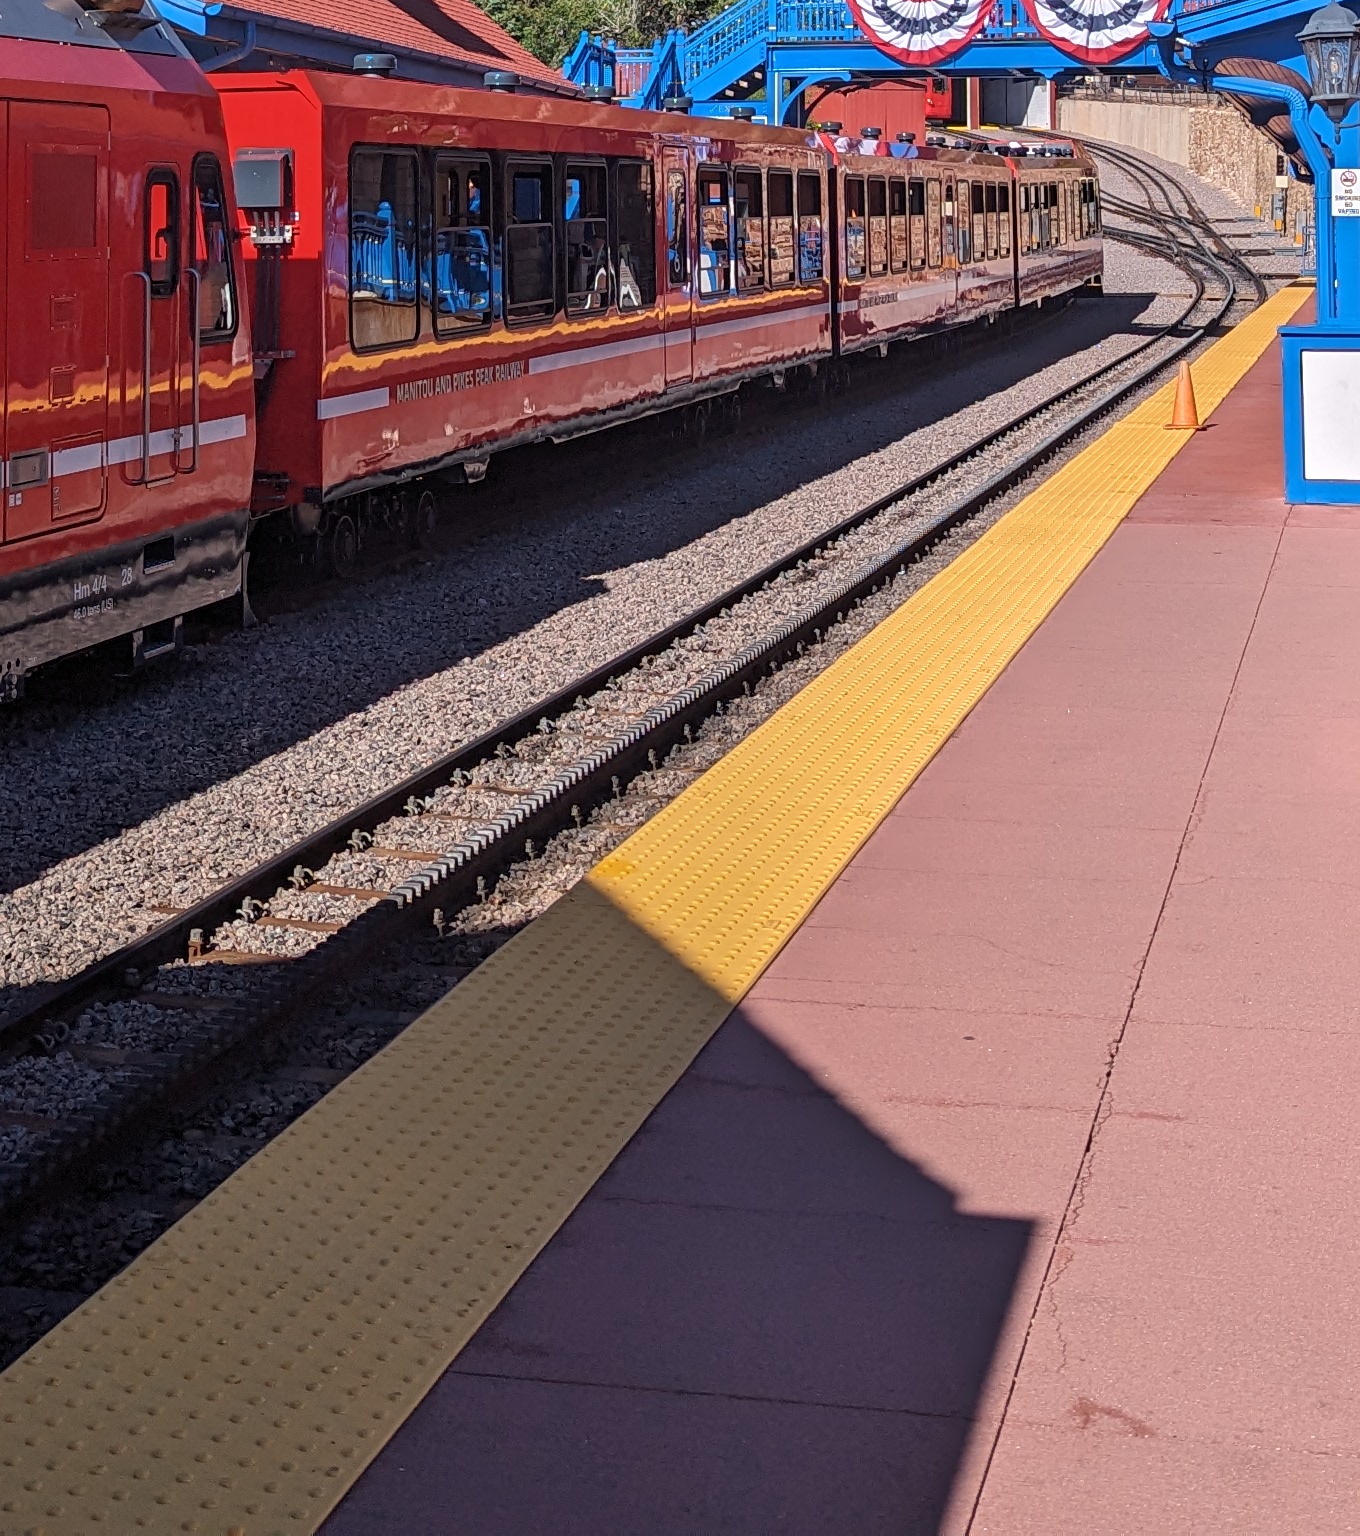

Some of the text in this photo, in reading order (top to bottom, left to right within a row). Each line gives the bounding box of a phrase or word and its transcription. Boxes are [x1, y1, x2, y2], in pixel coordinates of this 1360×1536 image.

[397, 361, 525, 404] MANITOU AND PIKES PEAK RAILWAY
[74, 568, 132, 601] Hm 4/4 28
